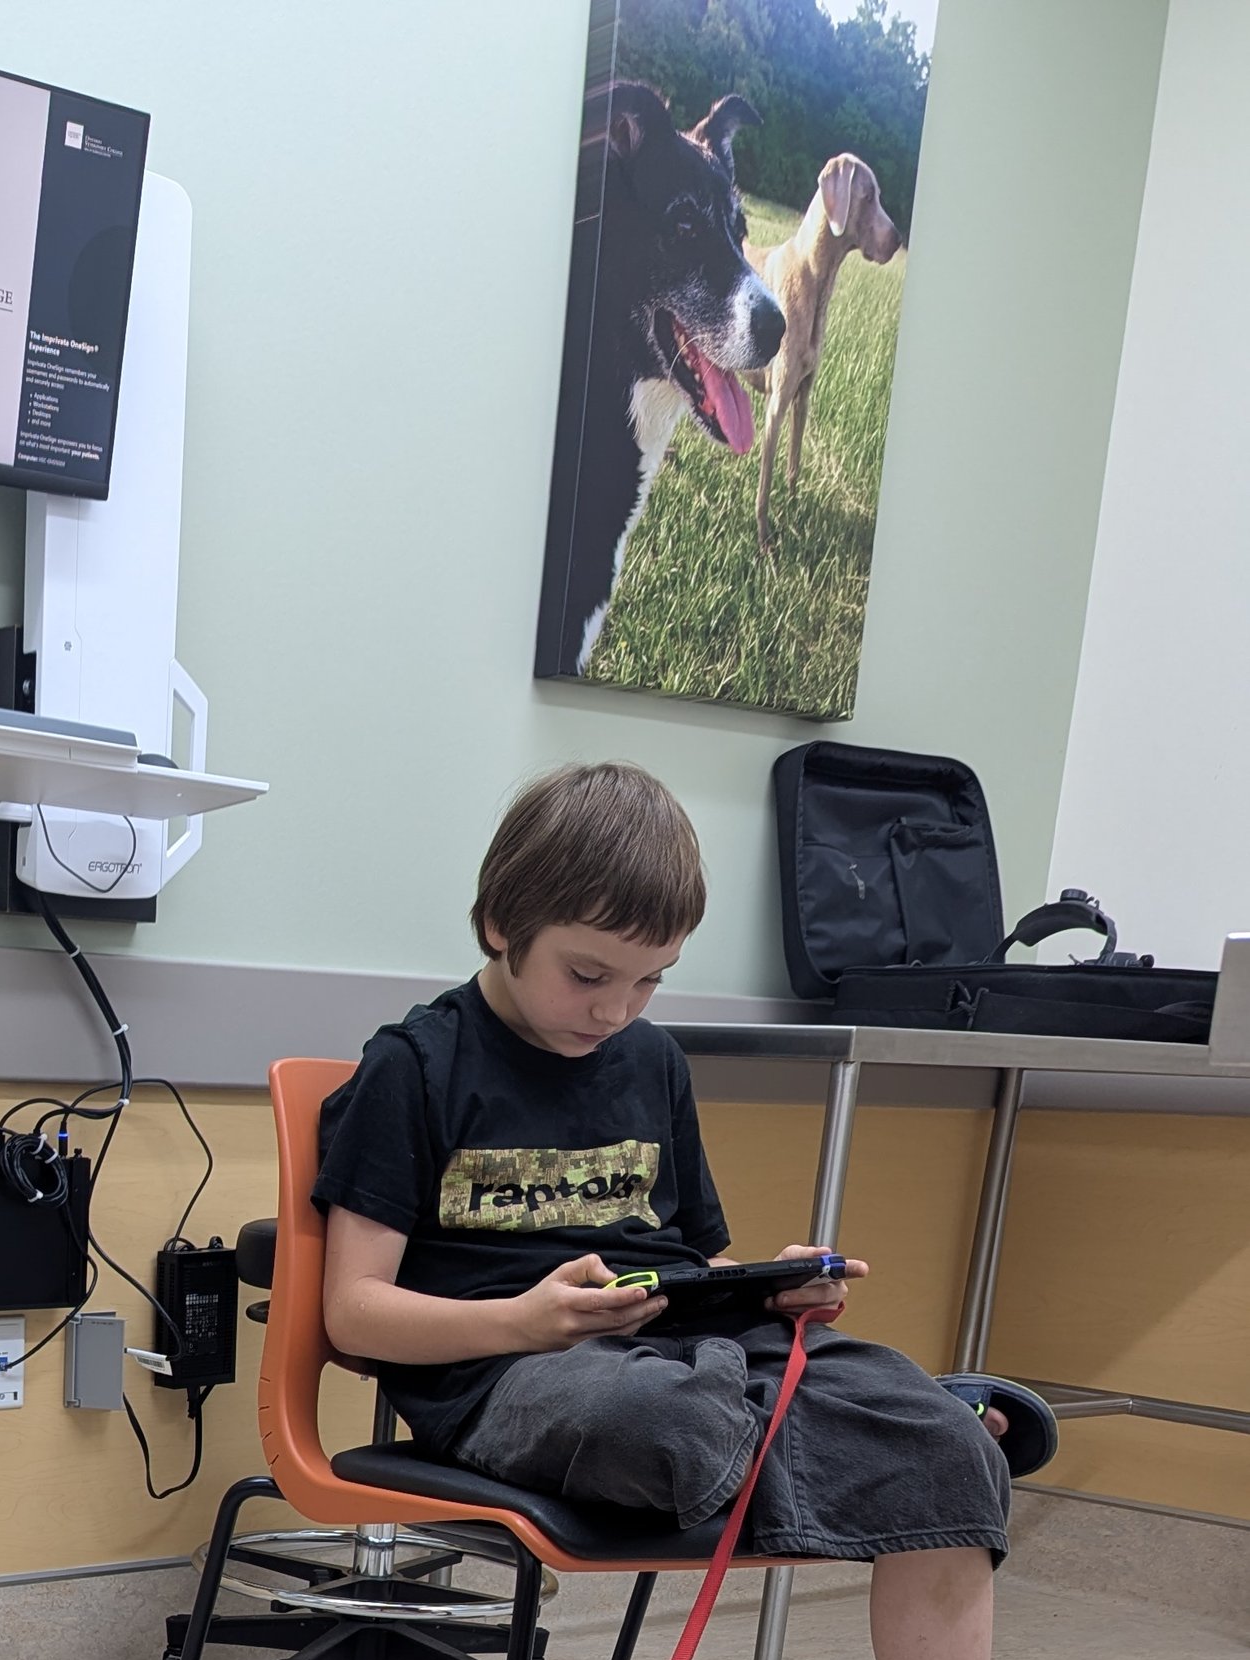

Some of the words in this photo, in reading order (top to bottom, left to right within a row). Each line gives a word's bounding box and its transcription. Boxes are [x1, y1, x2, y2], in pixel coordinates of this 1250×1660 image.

[30, 330, 41, 340] The
[29, 341, 60, 356] Experience
[48, 371, 57, 379] and
[34, 392, 59, 403] Applications
[33, 401, 59, 413] Workstations
